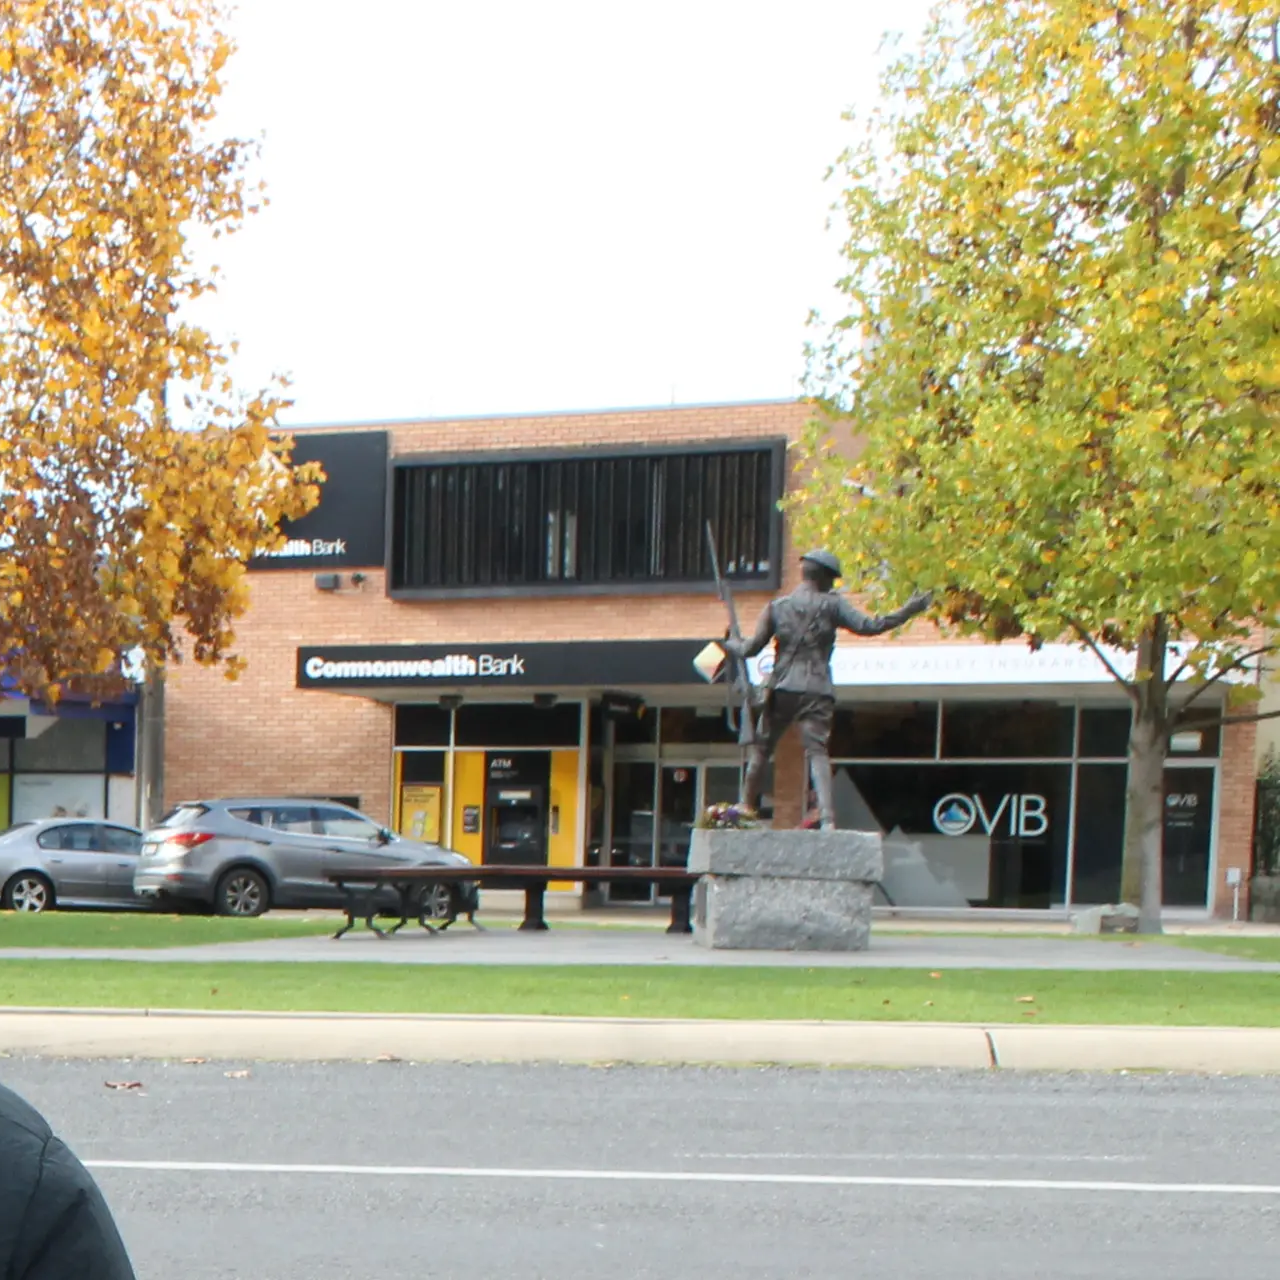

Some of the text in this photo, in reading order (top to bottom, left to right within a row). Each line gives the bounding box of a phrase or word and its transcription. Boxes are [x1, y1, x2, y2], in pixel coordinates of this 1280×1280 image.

[312, 538, 346, 556] Bank
[305, 654, 525, 678] Commonwealth Bank
[909, 659, 977, 670] VALLEY
[490, 758, 512, 769] ATM
